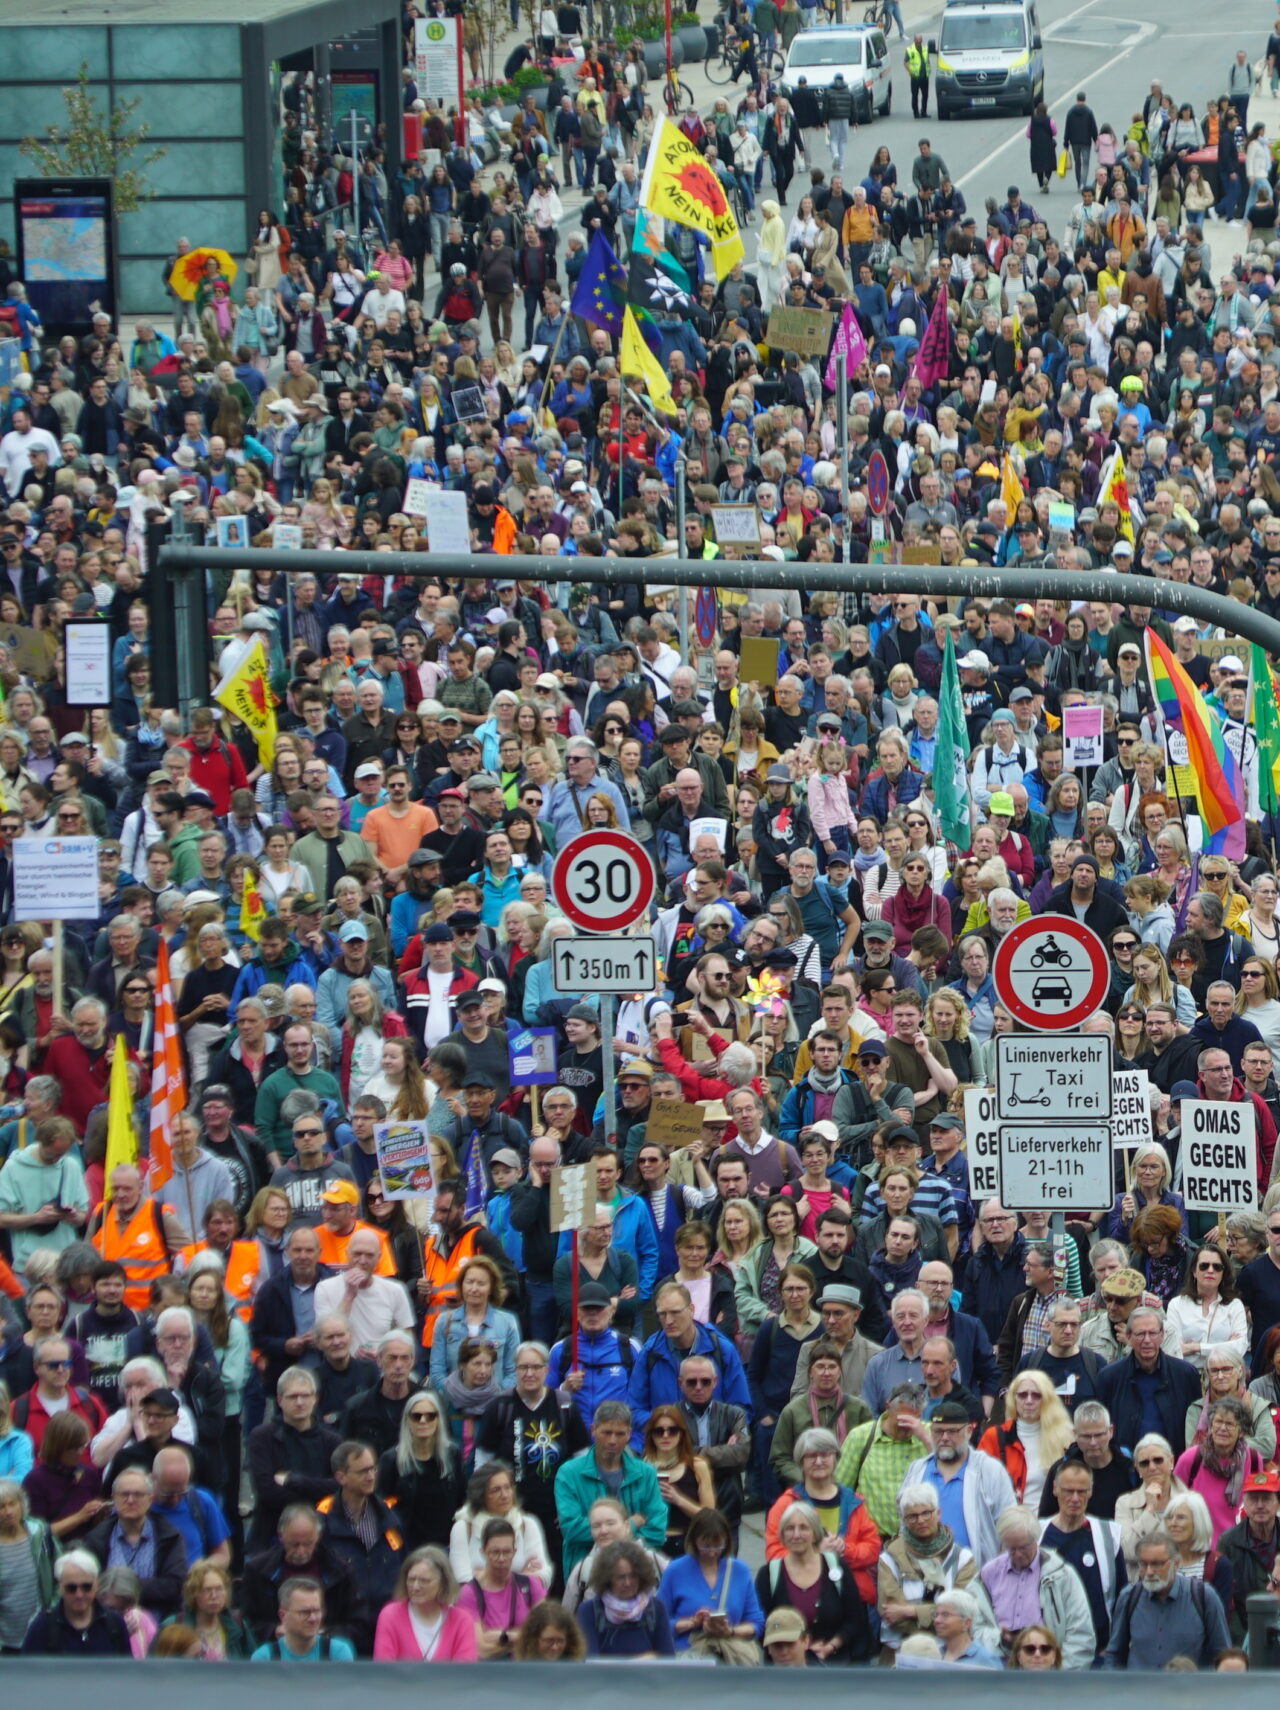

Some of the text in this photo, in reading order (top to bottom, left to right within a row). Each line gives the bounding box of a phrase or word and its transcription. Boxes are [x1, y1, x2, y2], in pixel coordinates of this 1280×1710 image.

[664, 185, 701, 222] NEIN
[1199, 644, 1250, 663] LOBB
[234, 688, 254, 722] NEIN
[574, 859, 632, 904] 30
[579, 958, 631, 980] 350m
[1005, 1046, 1103, 1064] Linienverkehr
[1046, 1069, 1084, 1086] Taxi
[1113, 1076, 1140, 1094] MAS
[1067, 1092, 1100, 1109] frei
[1113, 1097, 1145, 1115] EGEN
[1111, 1118, 1150, 1137] ECHTS
[1193, 1108, 1241, 1135] OMAS
[381, 1131, 420, 1147] ERNEUERBARE
[385, 1139, 421, 1153] ENERGIEN
[1007, 1136, 1103, 1153] Lieferverkehr
[1190, 1142, 1247, 1169] GEGEN
[1028, 1159, 1085, 1176] 21-11h
[413, 1175, 431, 1186] ödp
[1040, 1182, 1073, 1199] frei
[1187, 1176, 1253, 1204] RECHTS
[90, 1374, 121, 1388] LIFETI
